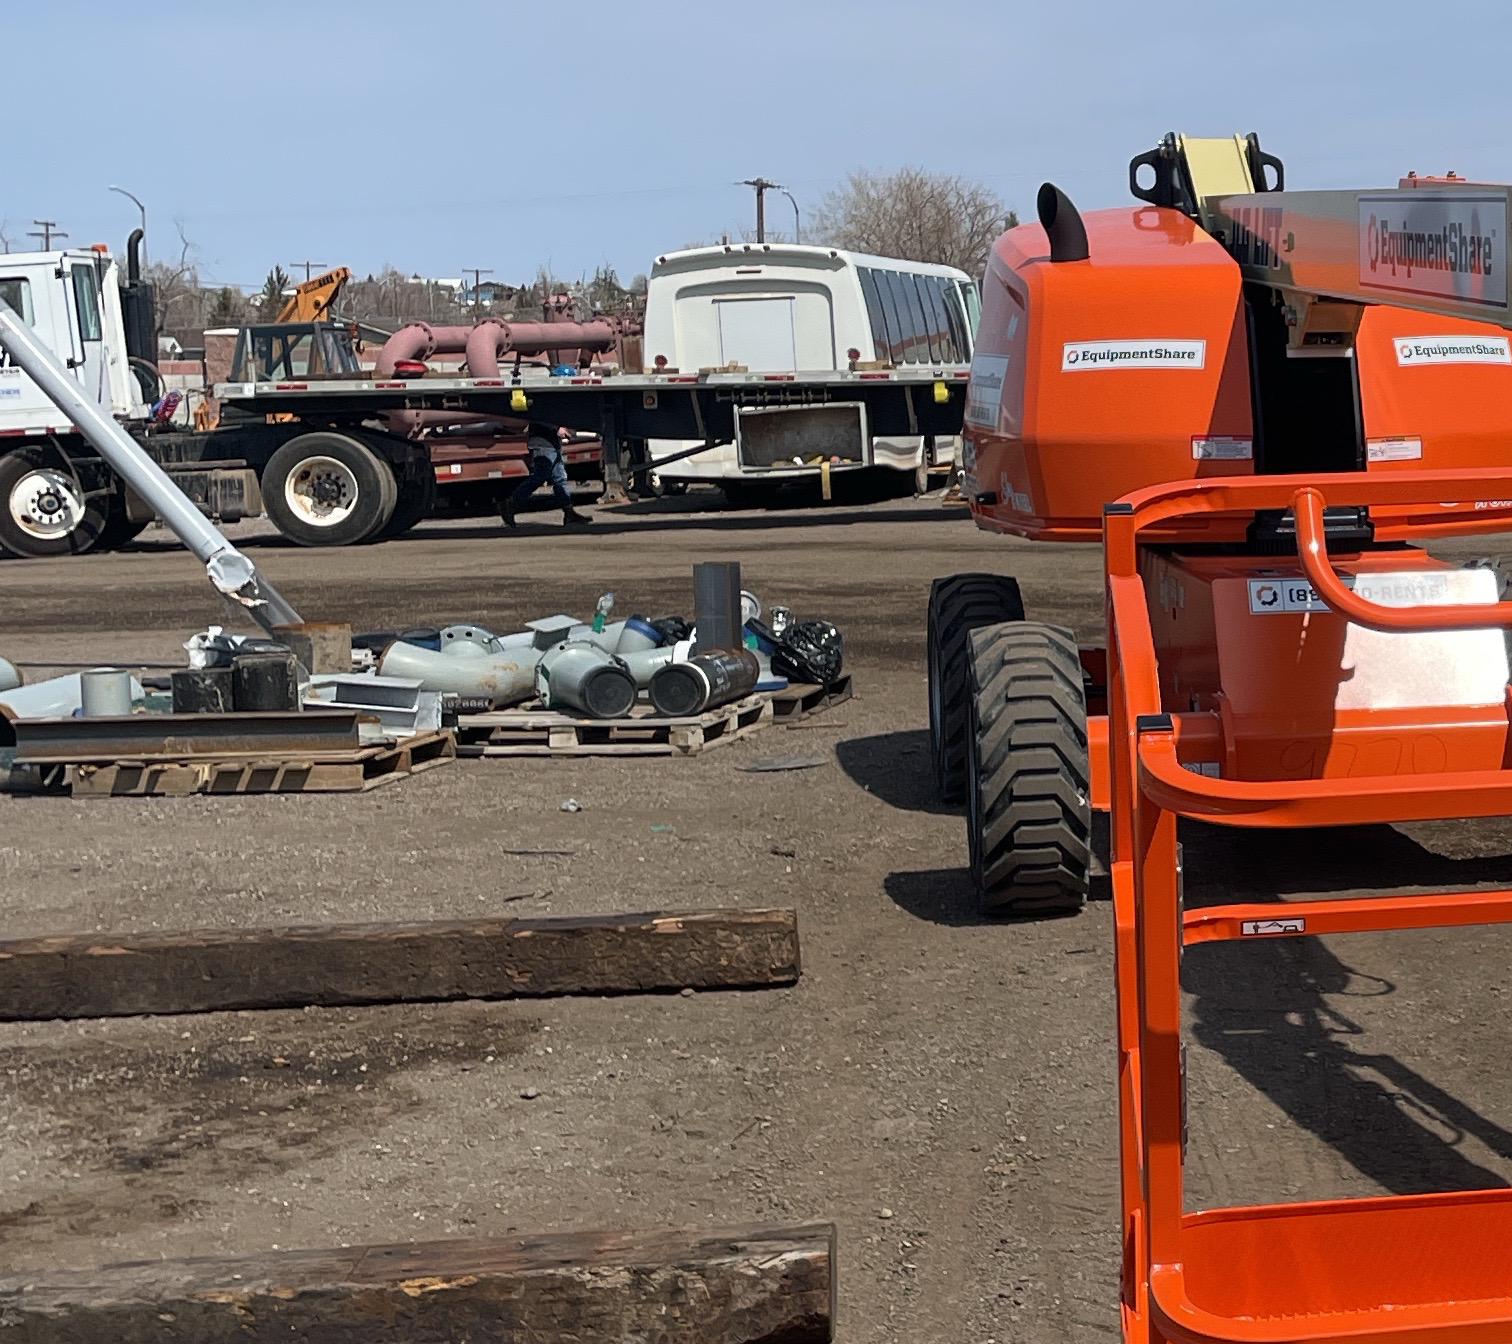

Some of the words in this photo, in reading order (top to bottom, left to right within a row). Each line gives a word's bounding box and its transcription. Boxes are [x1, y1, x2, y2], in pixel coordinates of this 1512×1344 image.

[1380, 219, 1493, 279] EquipmentShare
[1081, 348, 1196, 363] EquipmentShare
[1413, 342, 1505, 358] EquipmentShare
